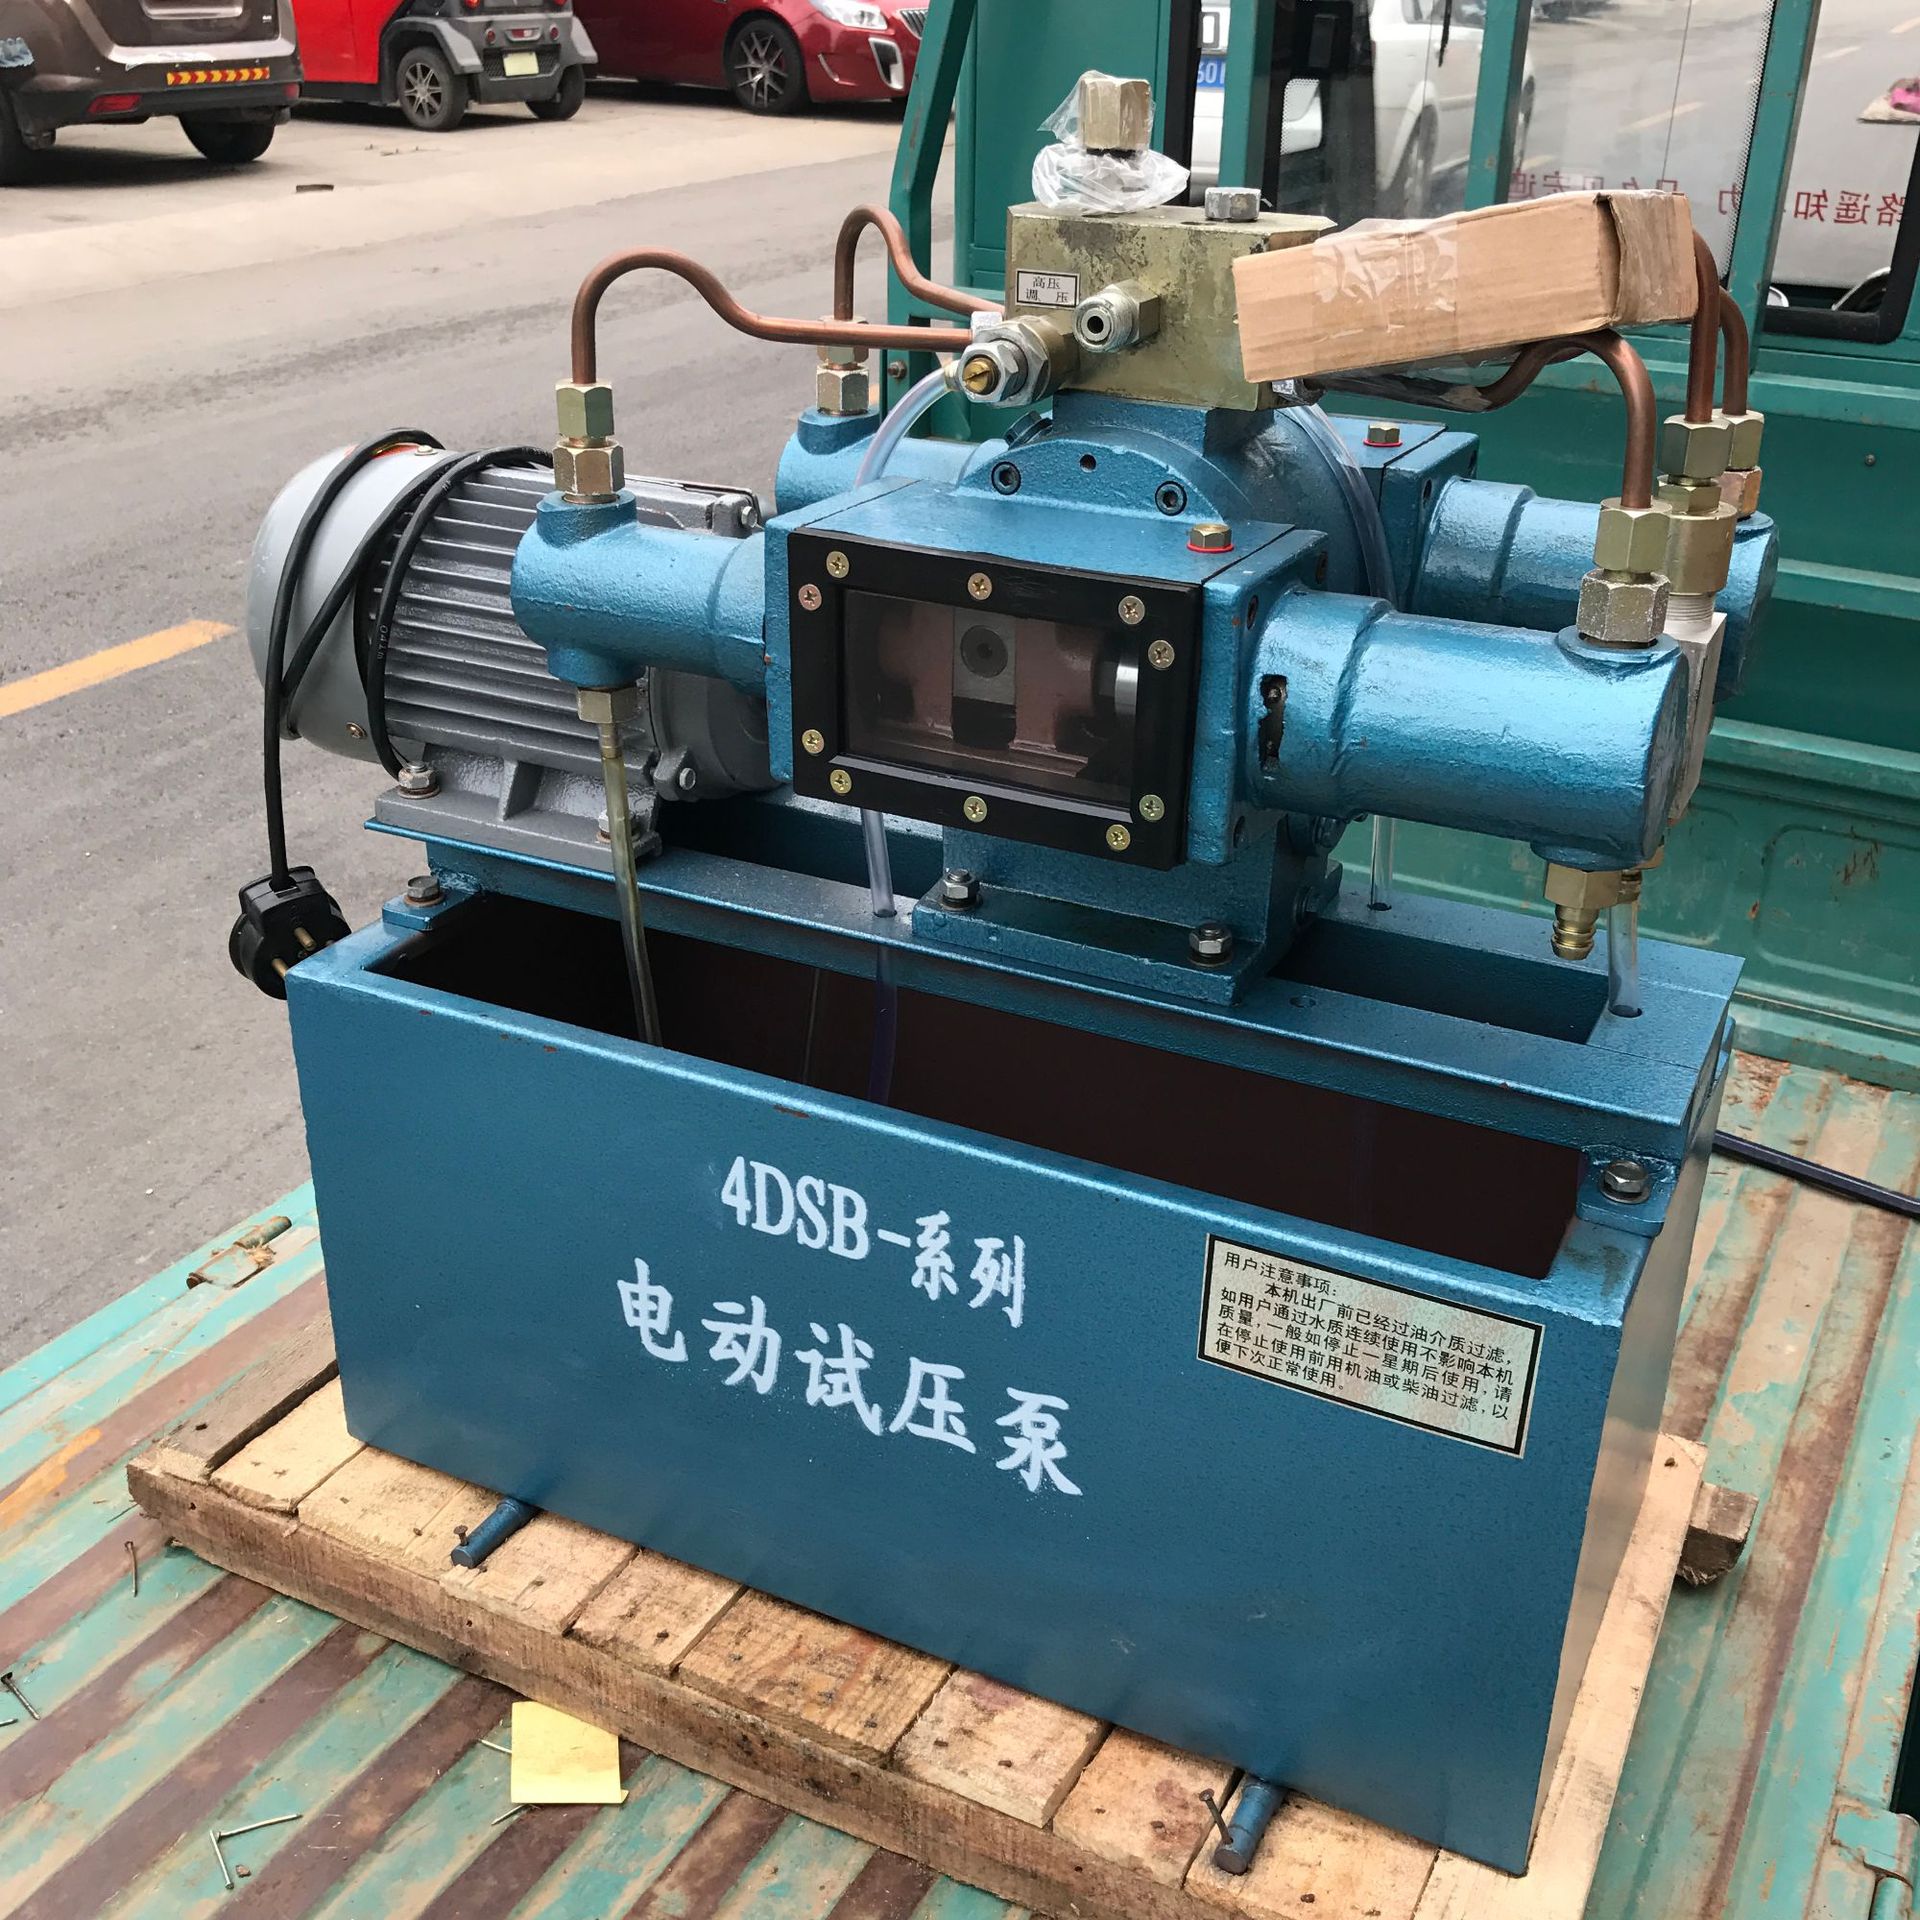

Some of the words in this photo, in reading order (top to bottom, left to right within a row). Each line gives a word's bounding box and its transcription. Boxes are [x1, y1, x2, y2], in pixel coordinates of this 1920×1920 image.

[1033, 276, 1061, 290] 高压
[1224, 1251, 1338, 1297] 用户注意事项：
[1215, 1338, 1345, 1391] 便下次正常使用。
[1218, 1304, 1513, 1404] 质量，一般如停止一星期后使用，请
[1220, 1286, 1514, 1387] 如用户通过水质连续使用不影响本机
[1265, 1282, 1511, 1365] 本机出厂前已经过油介质过滤，
[617, 1257, 1083, 1496] 电动试压泵
[1217, 1321, 1509, 1421] 在停止使用前用机油或柴油过滤，以
